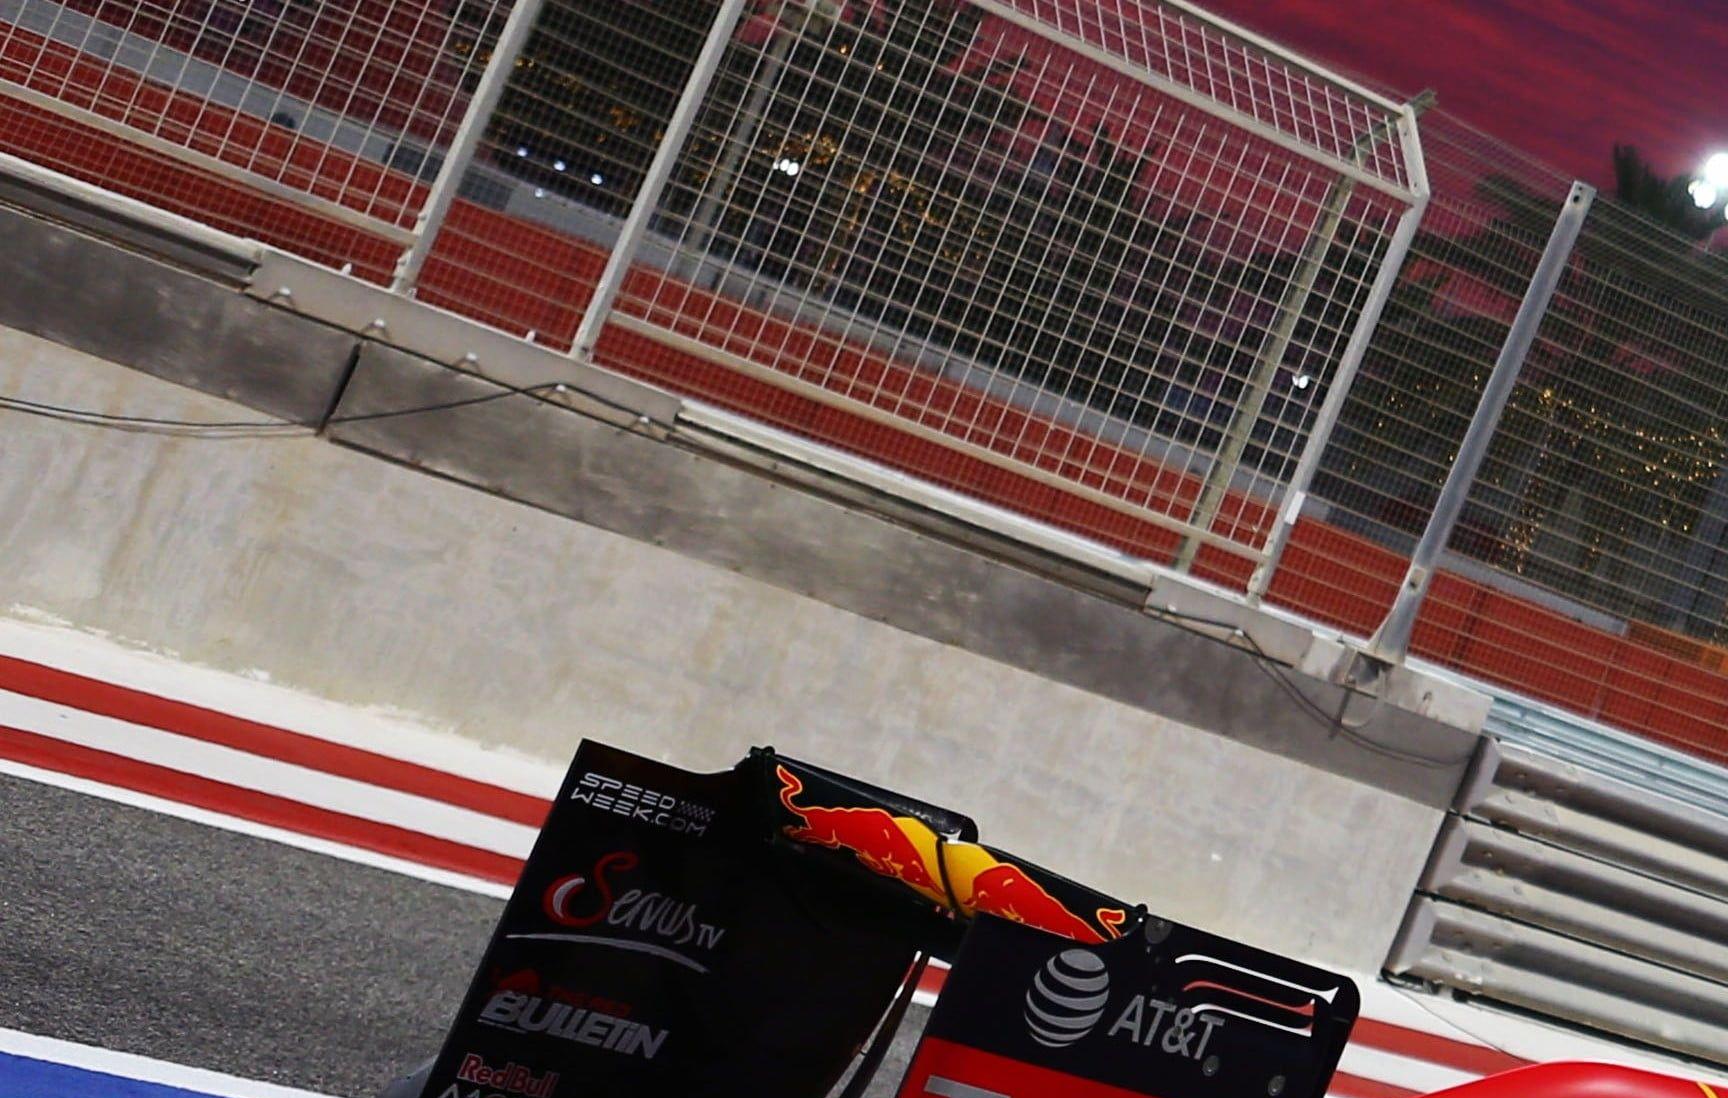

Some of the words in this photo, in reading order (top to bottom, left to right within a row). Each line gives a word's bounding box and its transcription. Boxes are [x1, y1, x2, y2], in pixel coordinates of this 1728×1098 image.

[570, 787, 707, 837] WEEK.COM
[579, 772, 676, 810] SPEED
[1107, 994, 1225, 1060] AT&T
